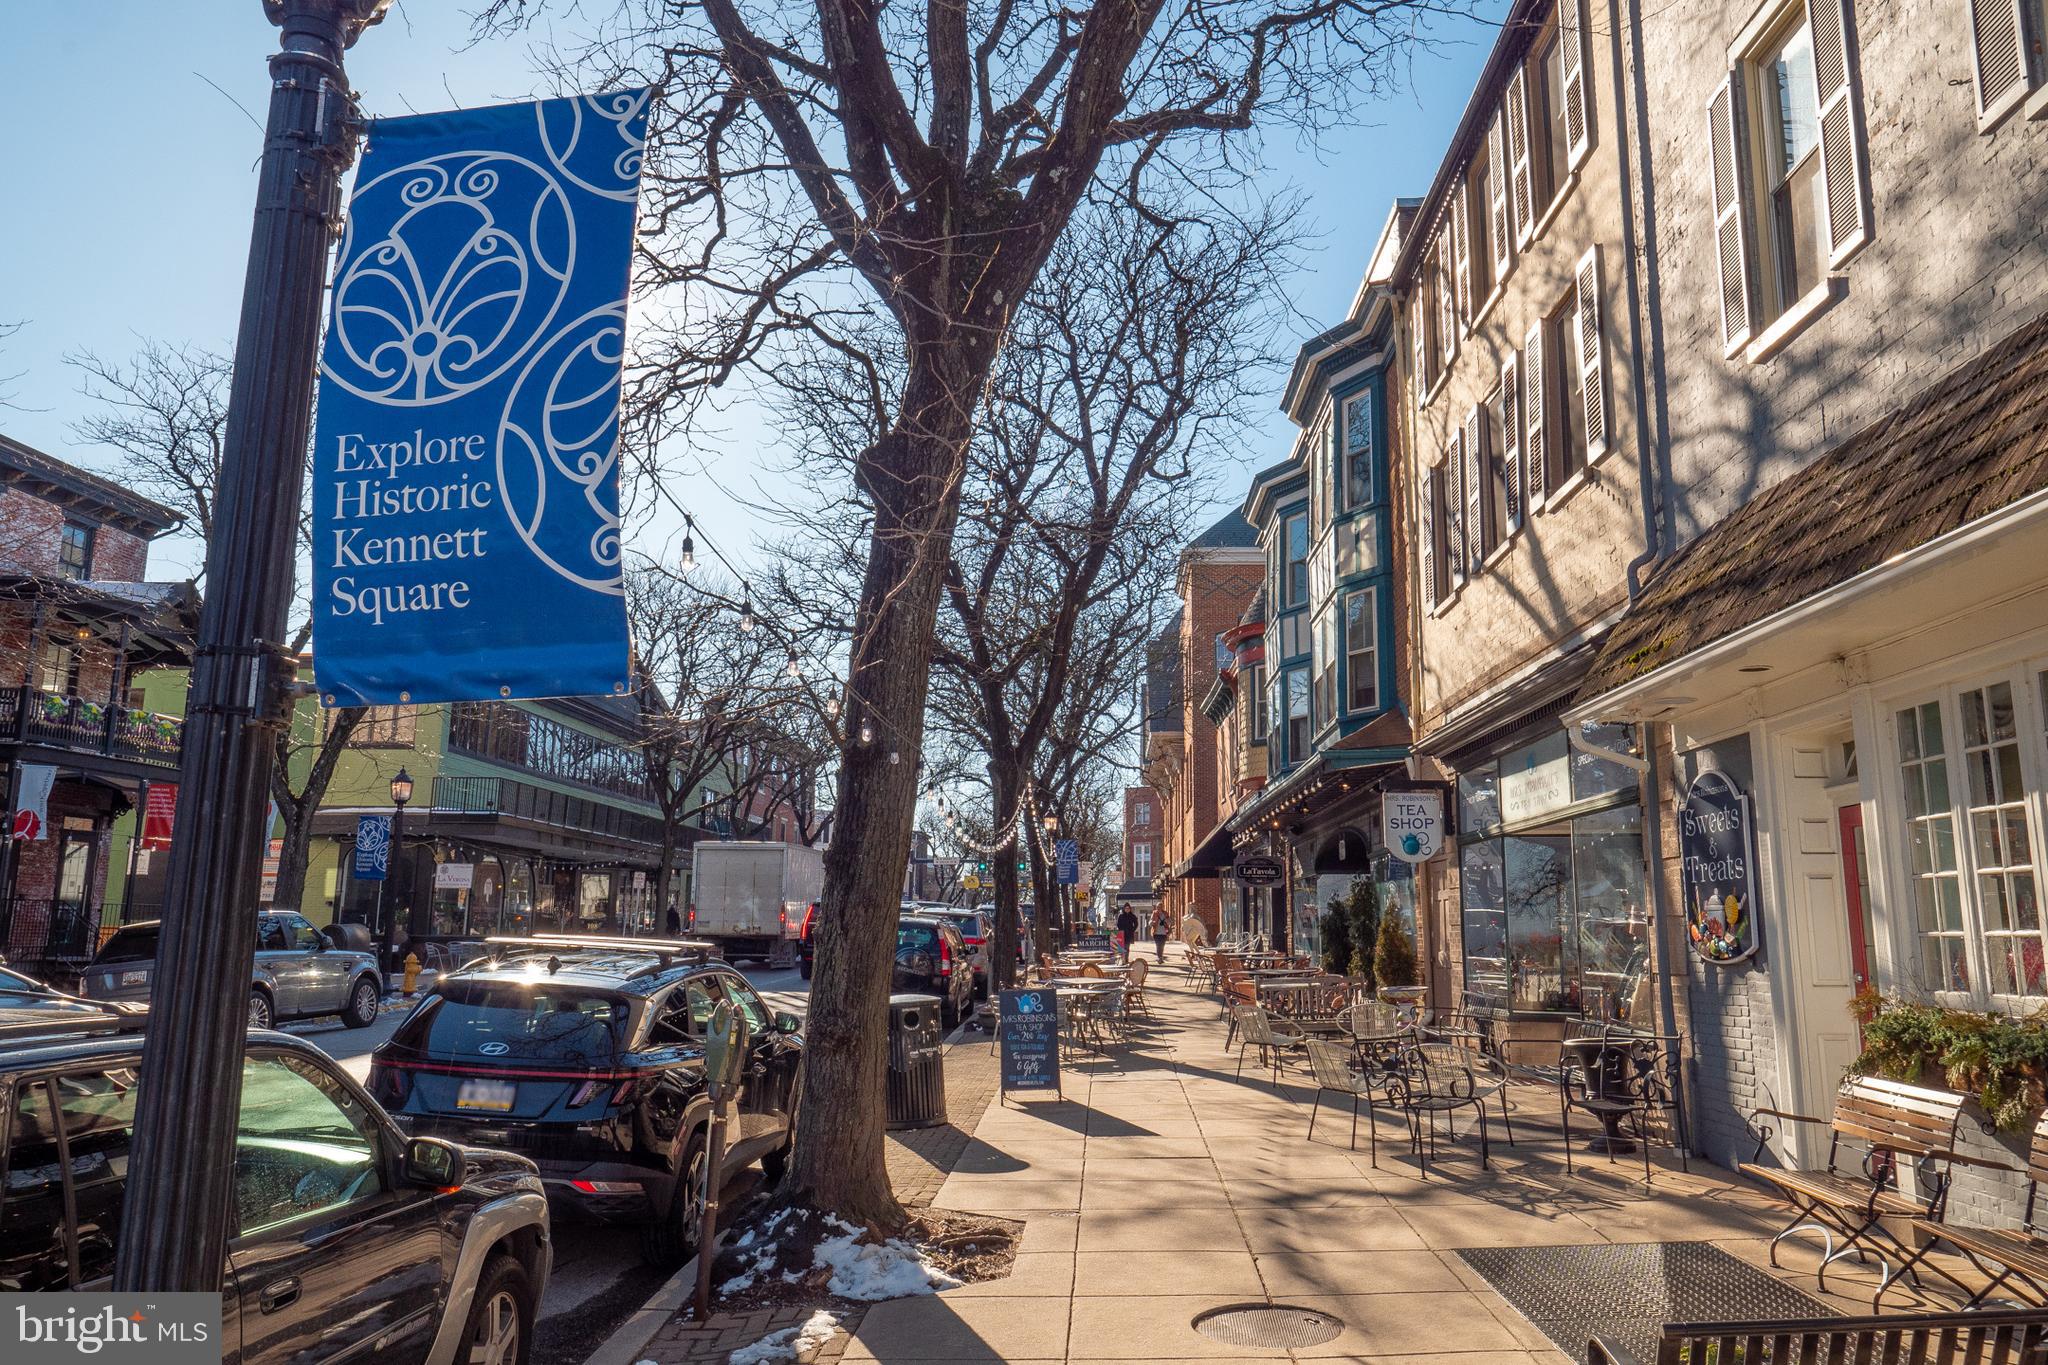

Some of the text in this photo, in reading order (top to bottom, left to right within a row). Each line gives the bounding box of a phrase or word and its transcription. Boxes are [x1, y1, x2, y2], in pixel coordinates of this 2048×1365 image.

[334, 428, 486, 479] Explore
[332, 473, 492, 520] Historic
[331, 527, 488, 568] Kennett
[331, 576, 471, 626] Square
[1390, 818, 1435, 829] SHOP
[1396, 804, 1427, 816] TEA
[1685, 803, 1740, 837] Sweets
[1708, 837, 1718, 859] &
[1685, 853, 1745, 884] Treats
